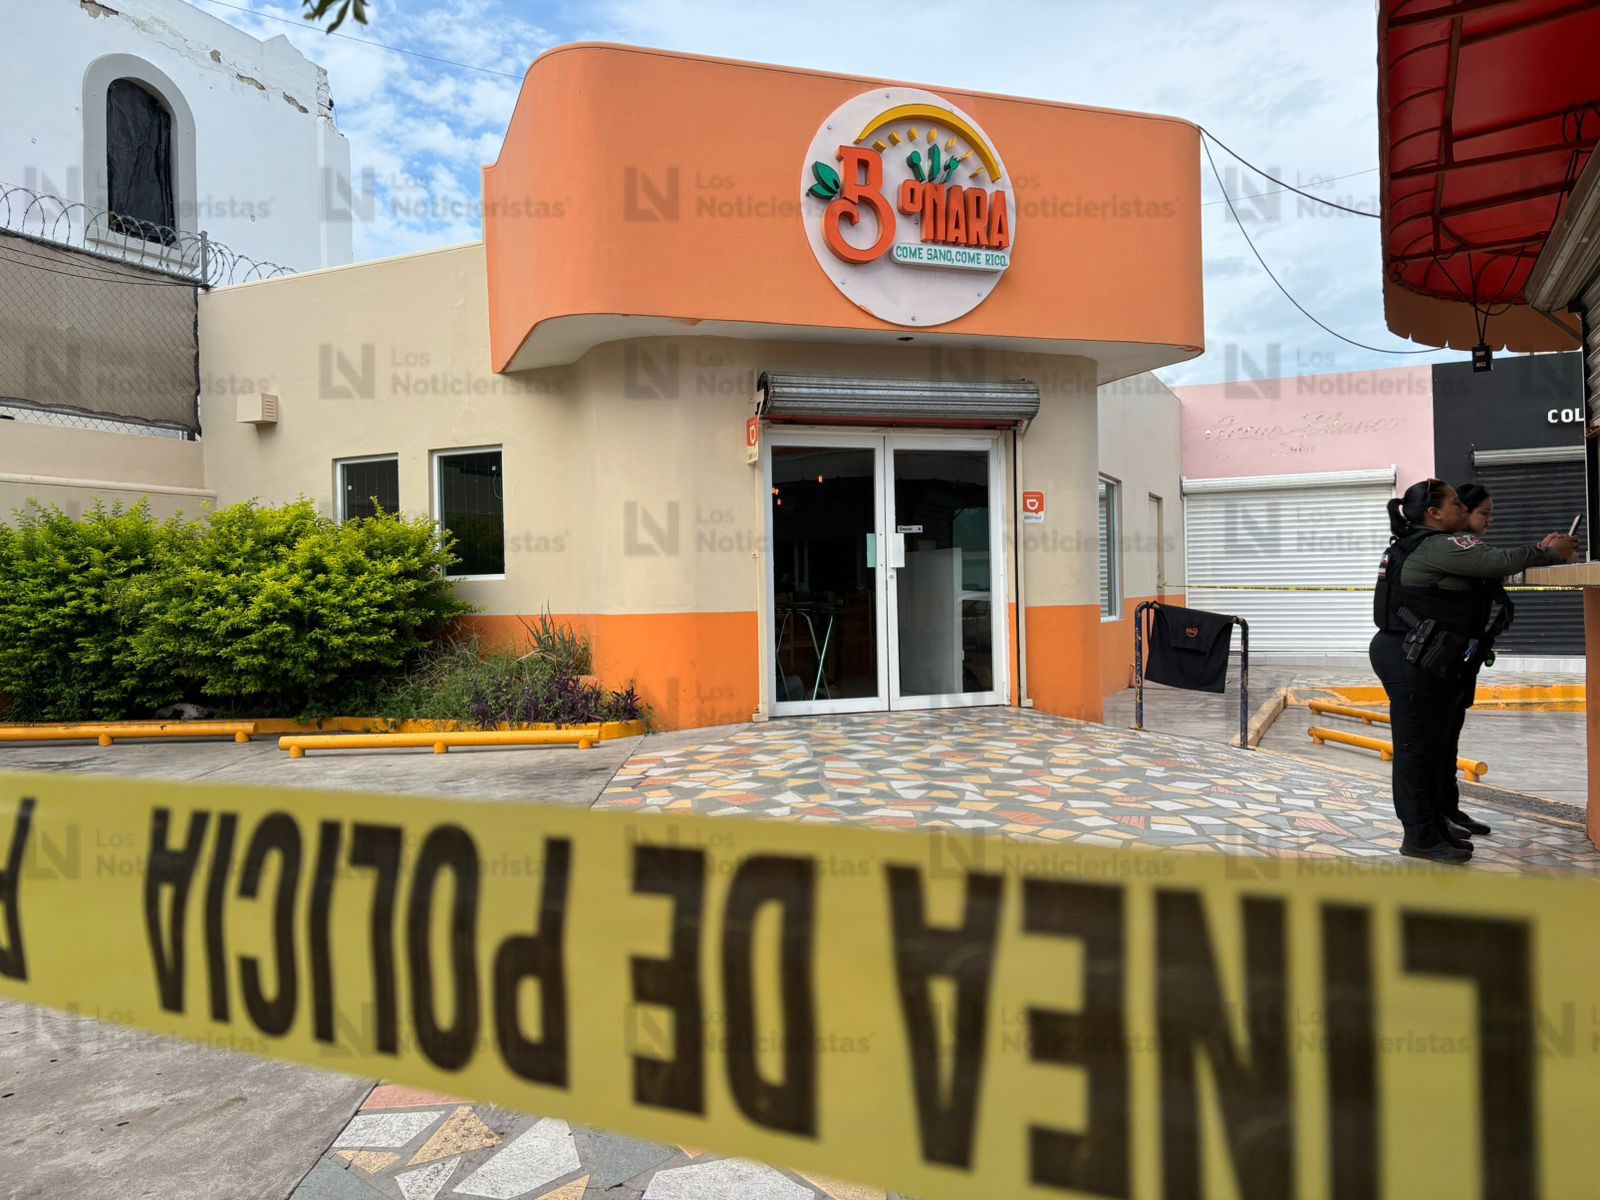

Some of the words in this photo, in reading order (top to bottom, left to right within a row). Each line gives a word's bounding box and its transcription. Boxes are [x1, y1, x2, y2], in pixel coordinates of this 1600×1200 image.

[895, 246, 924, 260] COME
[926, 248, 955, 264] SANO,
[955, 251, 982, 264] COME
[984, 253, 1008, 266] RICO.
[144, 804, 573, 1092] POLICIA
[630, 844, 819, 1146] DE
[883, 858, 1545, 1200] LINEA
